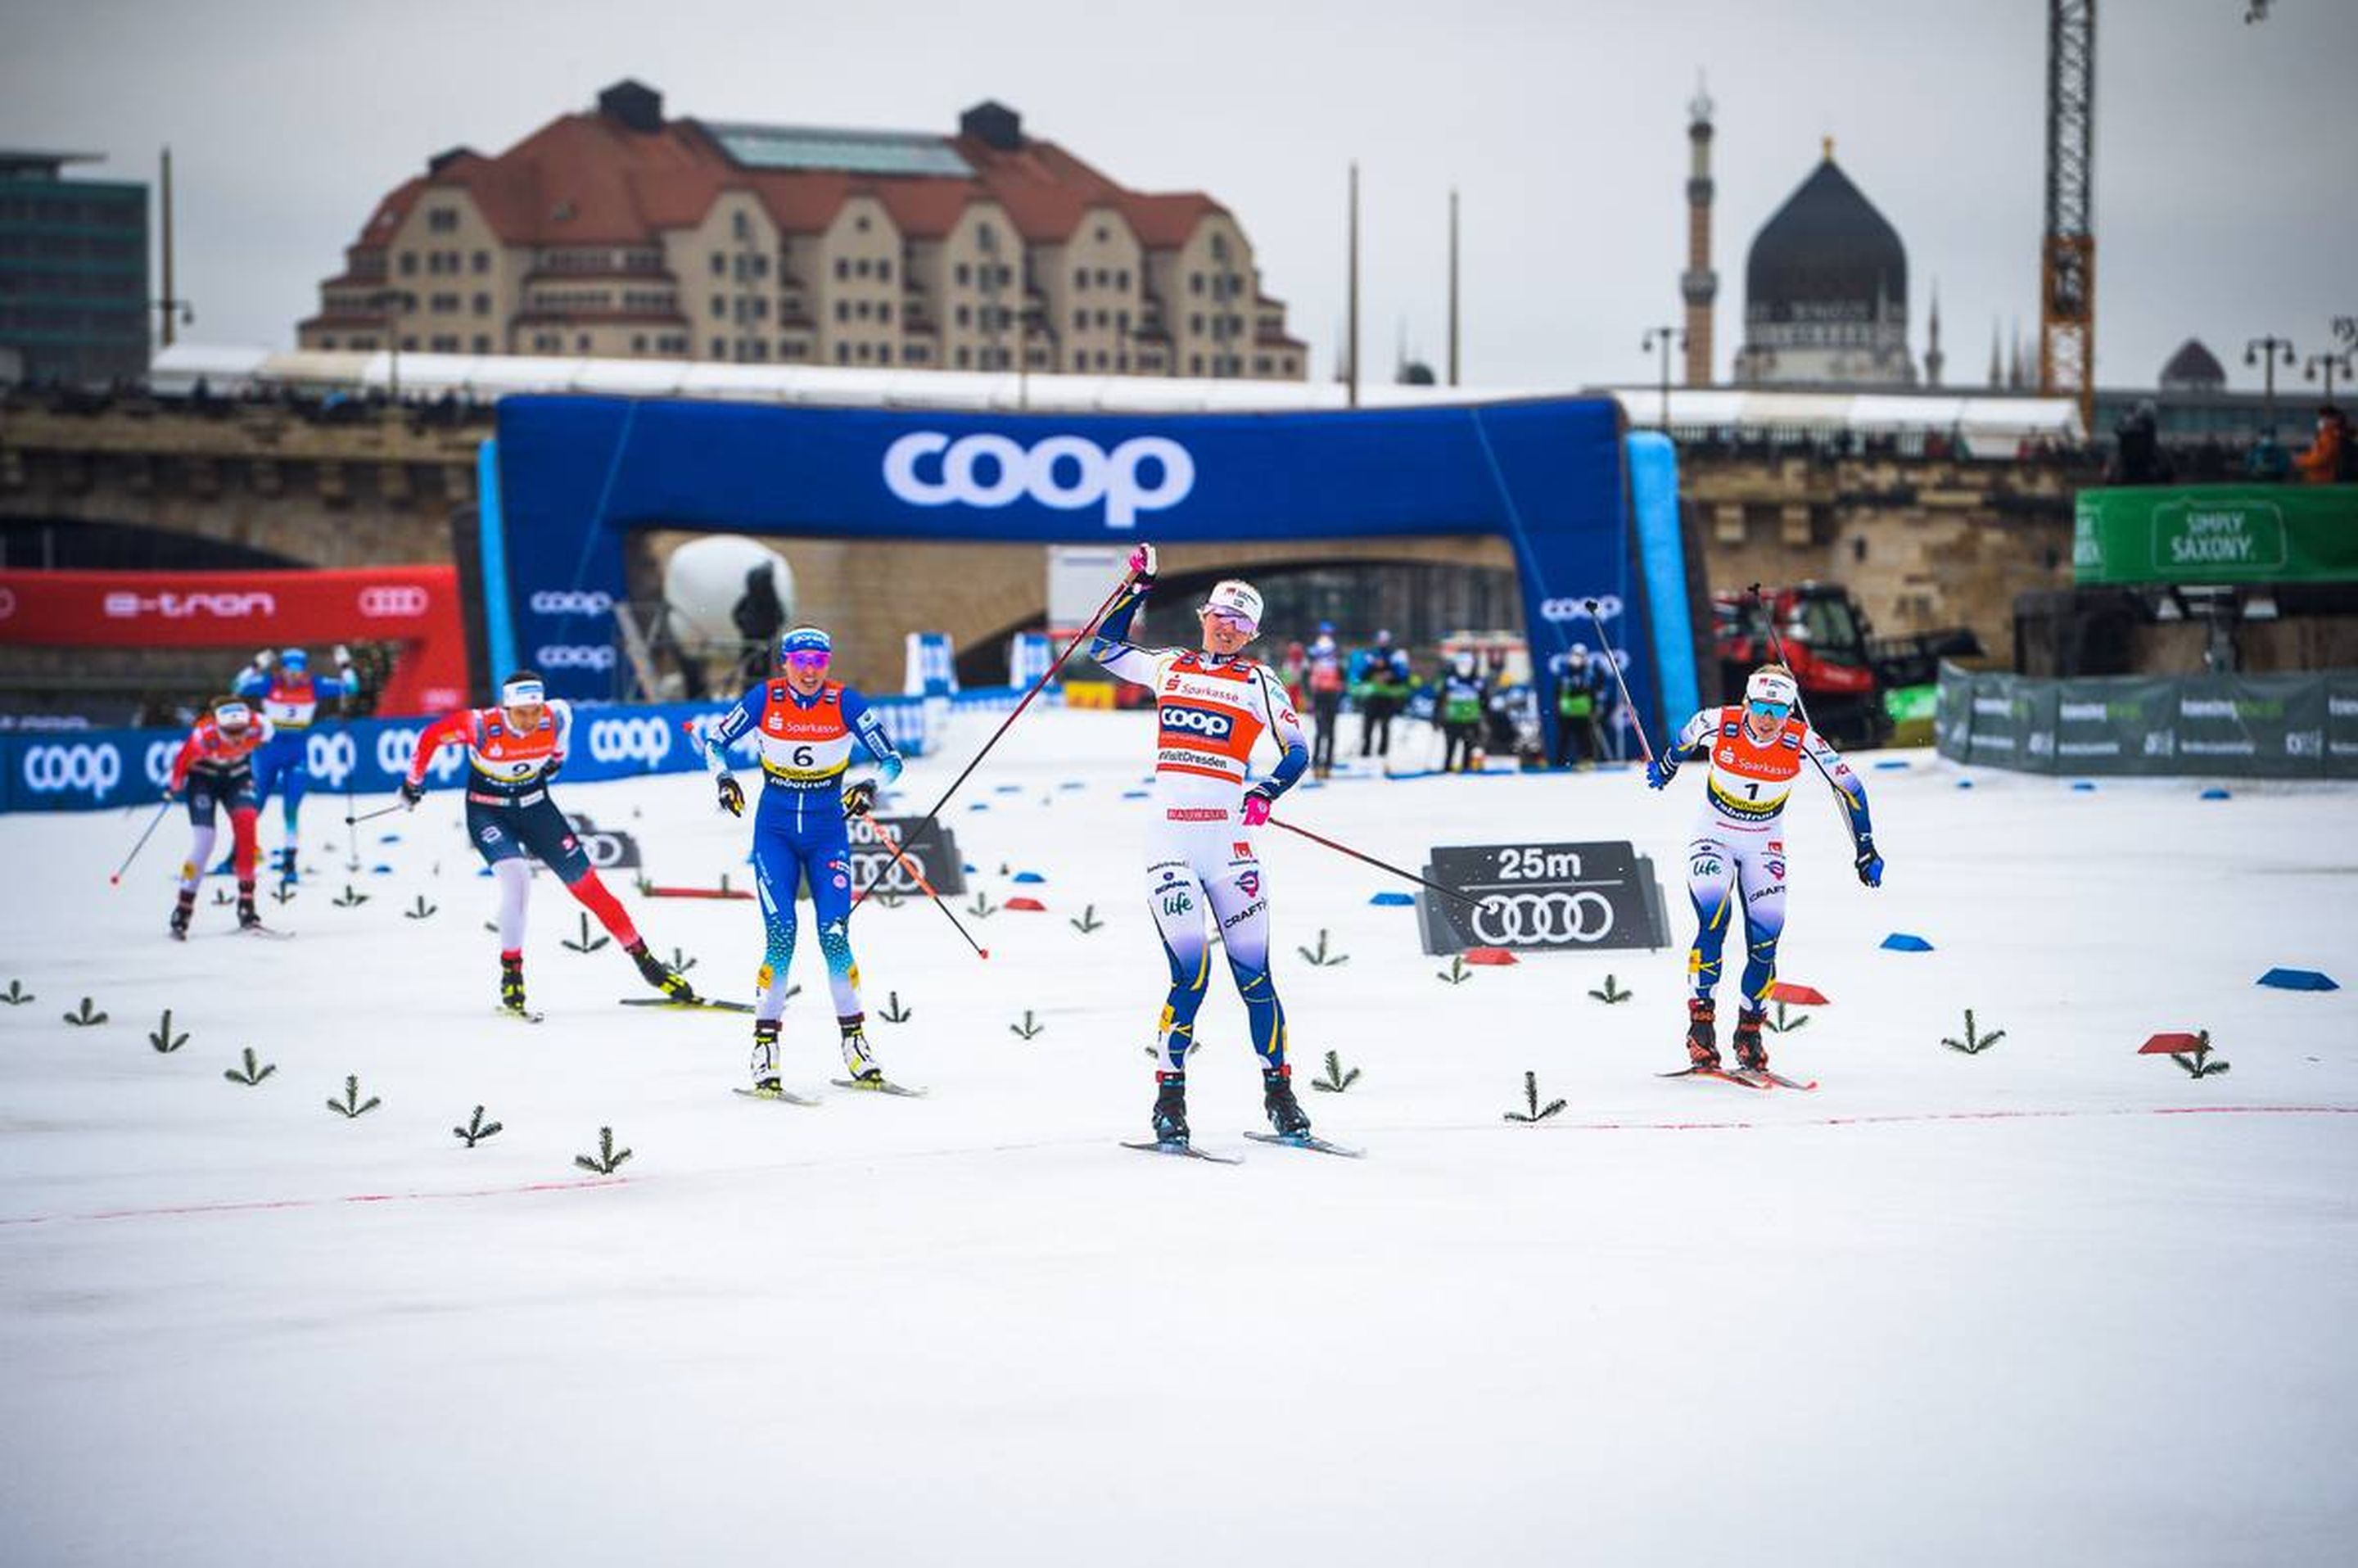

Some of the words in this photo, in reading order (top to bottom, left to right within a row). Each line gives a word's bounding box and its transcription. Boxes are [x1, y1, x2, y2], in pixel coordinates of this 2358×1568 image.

[883, 431, 1195, 528] coop
[2186, 511, 2246, 534] SIMPLY
[105, 591, 276, 617] e-tron
[531, 590, 612, 617] coop
[535, 644, 617, 672] coop
[1181, 683, 1239, 703] Sparkasse
[786, 721, 839, 734] Sparkasse
[1162, 707, 1228, 735] coop
[590, 716, 671, 769] coop
[307, 731, 357, 788] op
[793, 746, 815, 767] 6
[23, 741, 120, 799] coop
[1744, 783, 1759, 801] 1
[1497, 847, 1581, 879] 25m
[1693, 859, 1722, 876] life
[1163, 892, 1194, 916] life
